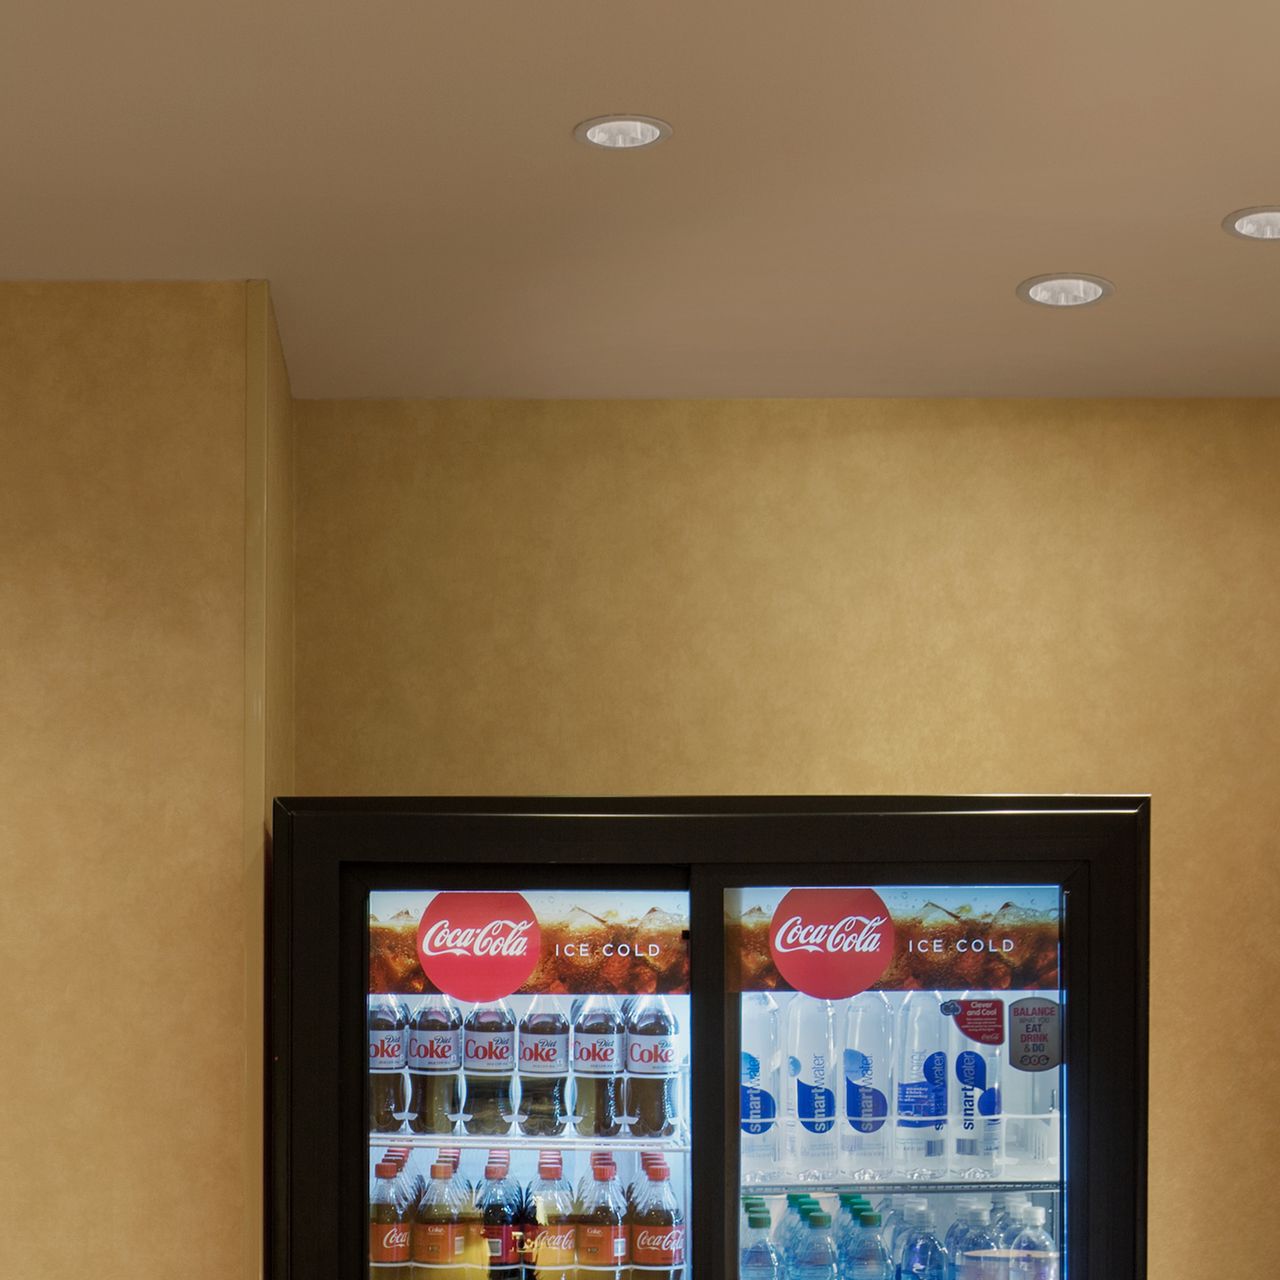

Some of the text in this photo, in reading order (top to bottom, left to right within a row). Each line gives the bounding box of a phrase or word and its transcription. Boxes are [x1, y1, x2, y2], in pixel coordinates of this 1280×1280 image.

[422, 919, 534, 956] Coca-Cola
[775, 916, 887, 952] Coca-Cola
[555, 943, 660, 957] ICE COLD
[909, 939, 1014, 953] ICE COLD
[1014, 1007, 1055, 1016] BALANCE
[1026, 1024, 1041, 1032] EAT
[409, 1038, 452, 1058] Coke
[1021, 1034, 1048, 1043] DRINK
[370, 1040, 401, 1058] oke
[466, 1039, 509, 1060] Coke
[574, 1041, 614, 1062] Coke
[630, 1043, 674, 1062] Coke
[812, 1053, 826, 1132] smartwater
[858, 1054, 873, 1131] smartwater
[961, 1052, 975, 1130] smartwater
